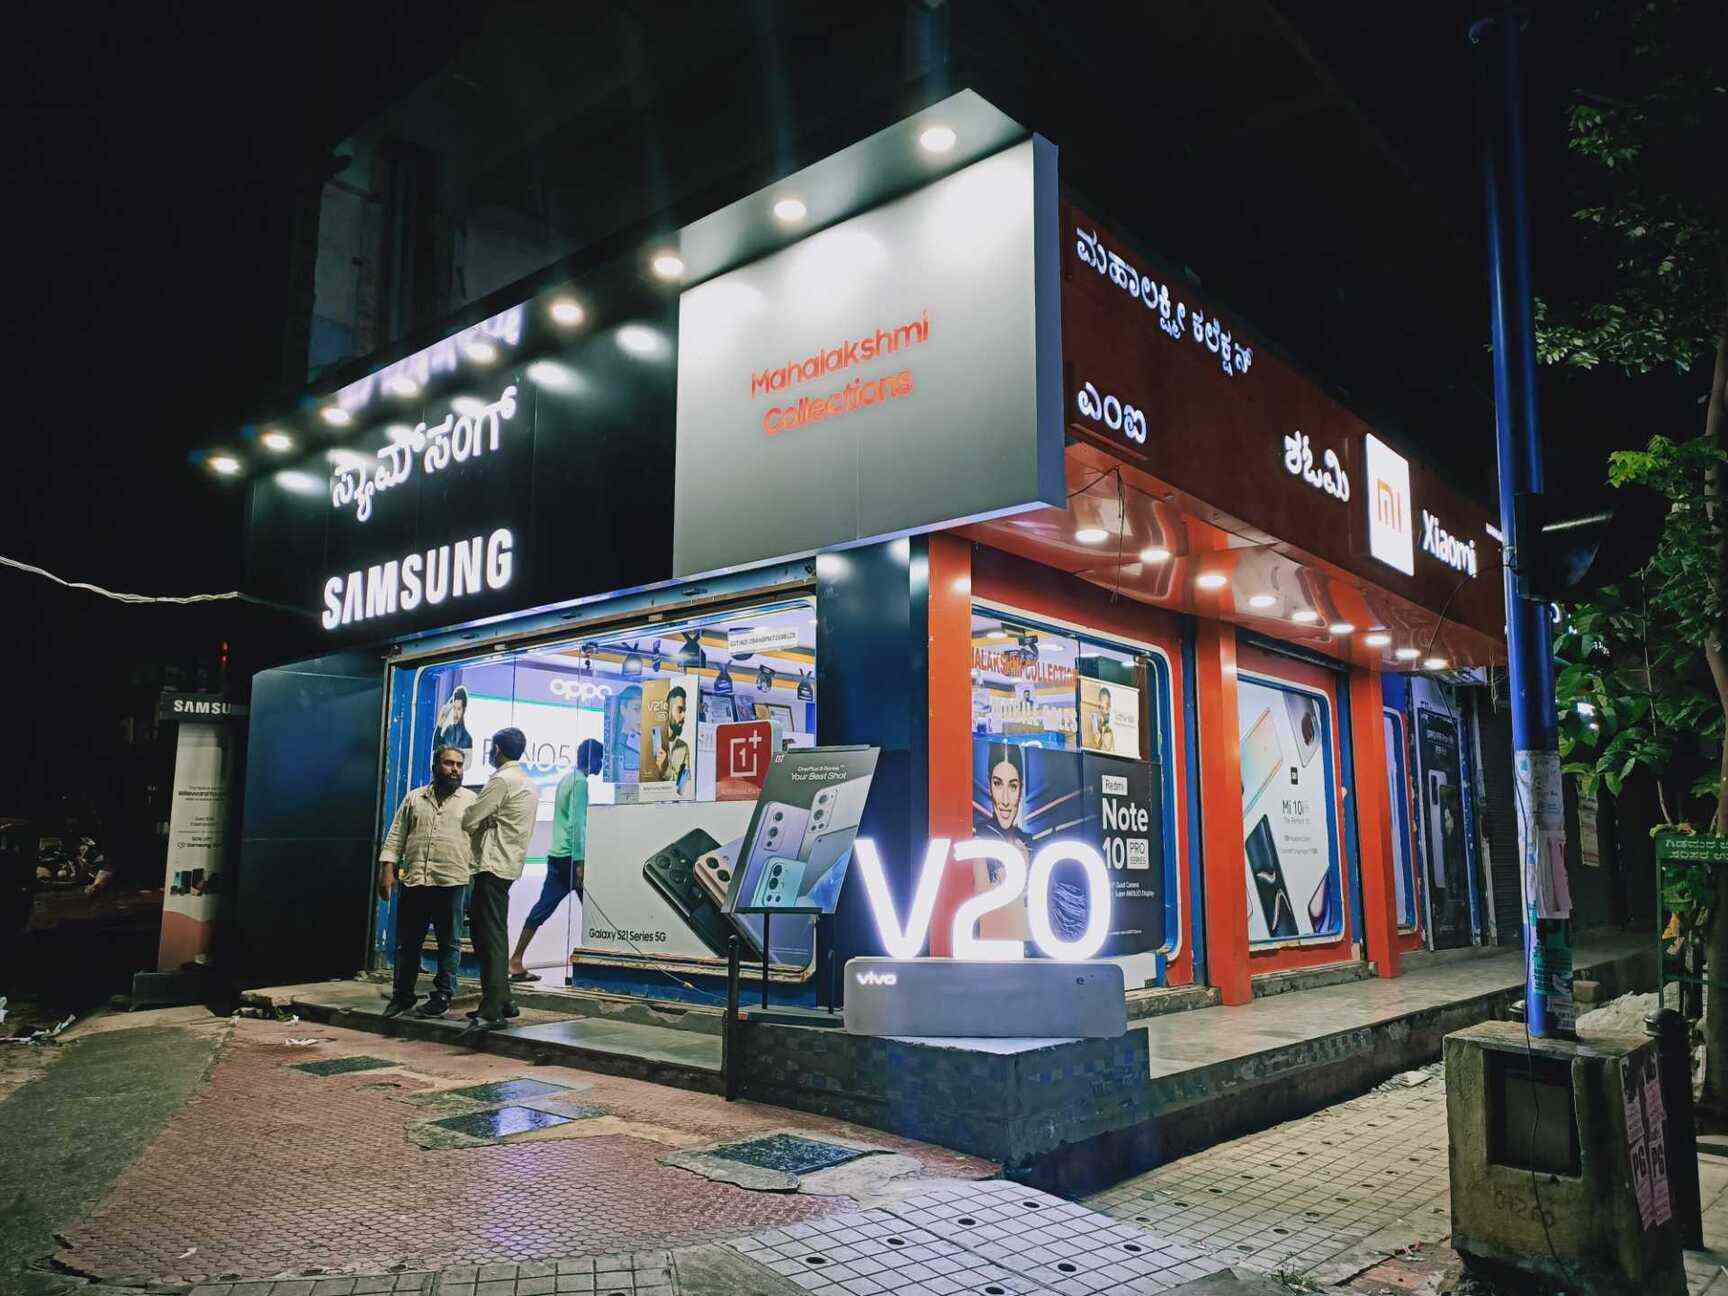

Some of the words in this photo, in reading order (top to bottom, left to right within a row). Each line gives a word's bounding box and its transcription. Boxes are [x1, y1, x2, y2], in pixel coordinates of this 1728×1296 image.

[763, 369, 914, 436] Collections
[1422, 508, 1477, 579] Xiaomi
[321, 527, 514, 631] SAMSUNG
[173, 699, 232, 715] SAMSU
[791, 773, 807, 781] Your
[808, 772, 827, 781] Best
[828, 771, 847, 780] Shot
[1105, 779, 1124, 791] Redmi
[1102, 797, 1148, 832] Note
[1102, 836, 1125, 870] 10
[1130, 842, 1145, 854] PRO
[853, 838, 1111, 962] V20
[589, 928, 615, 940] Galaxy
[629, 931, 654, 942] Series
[655, 931, 667, 942] 5G
[856, 971, 898, 986] vivo
